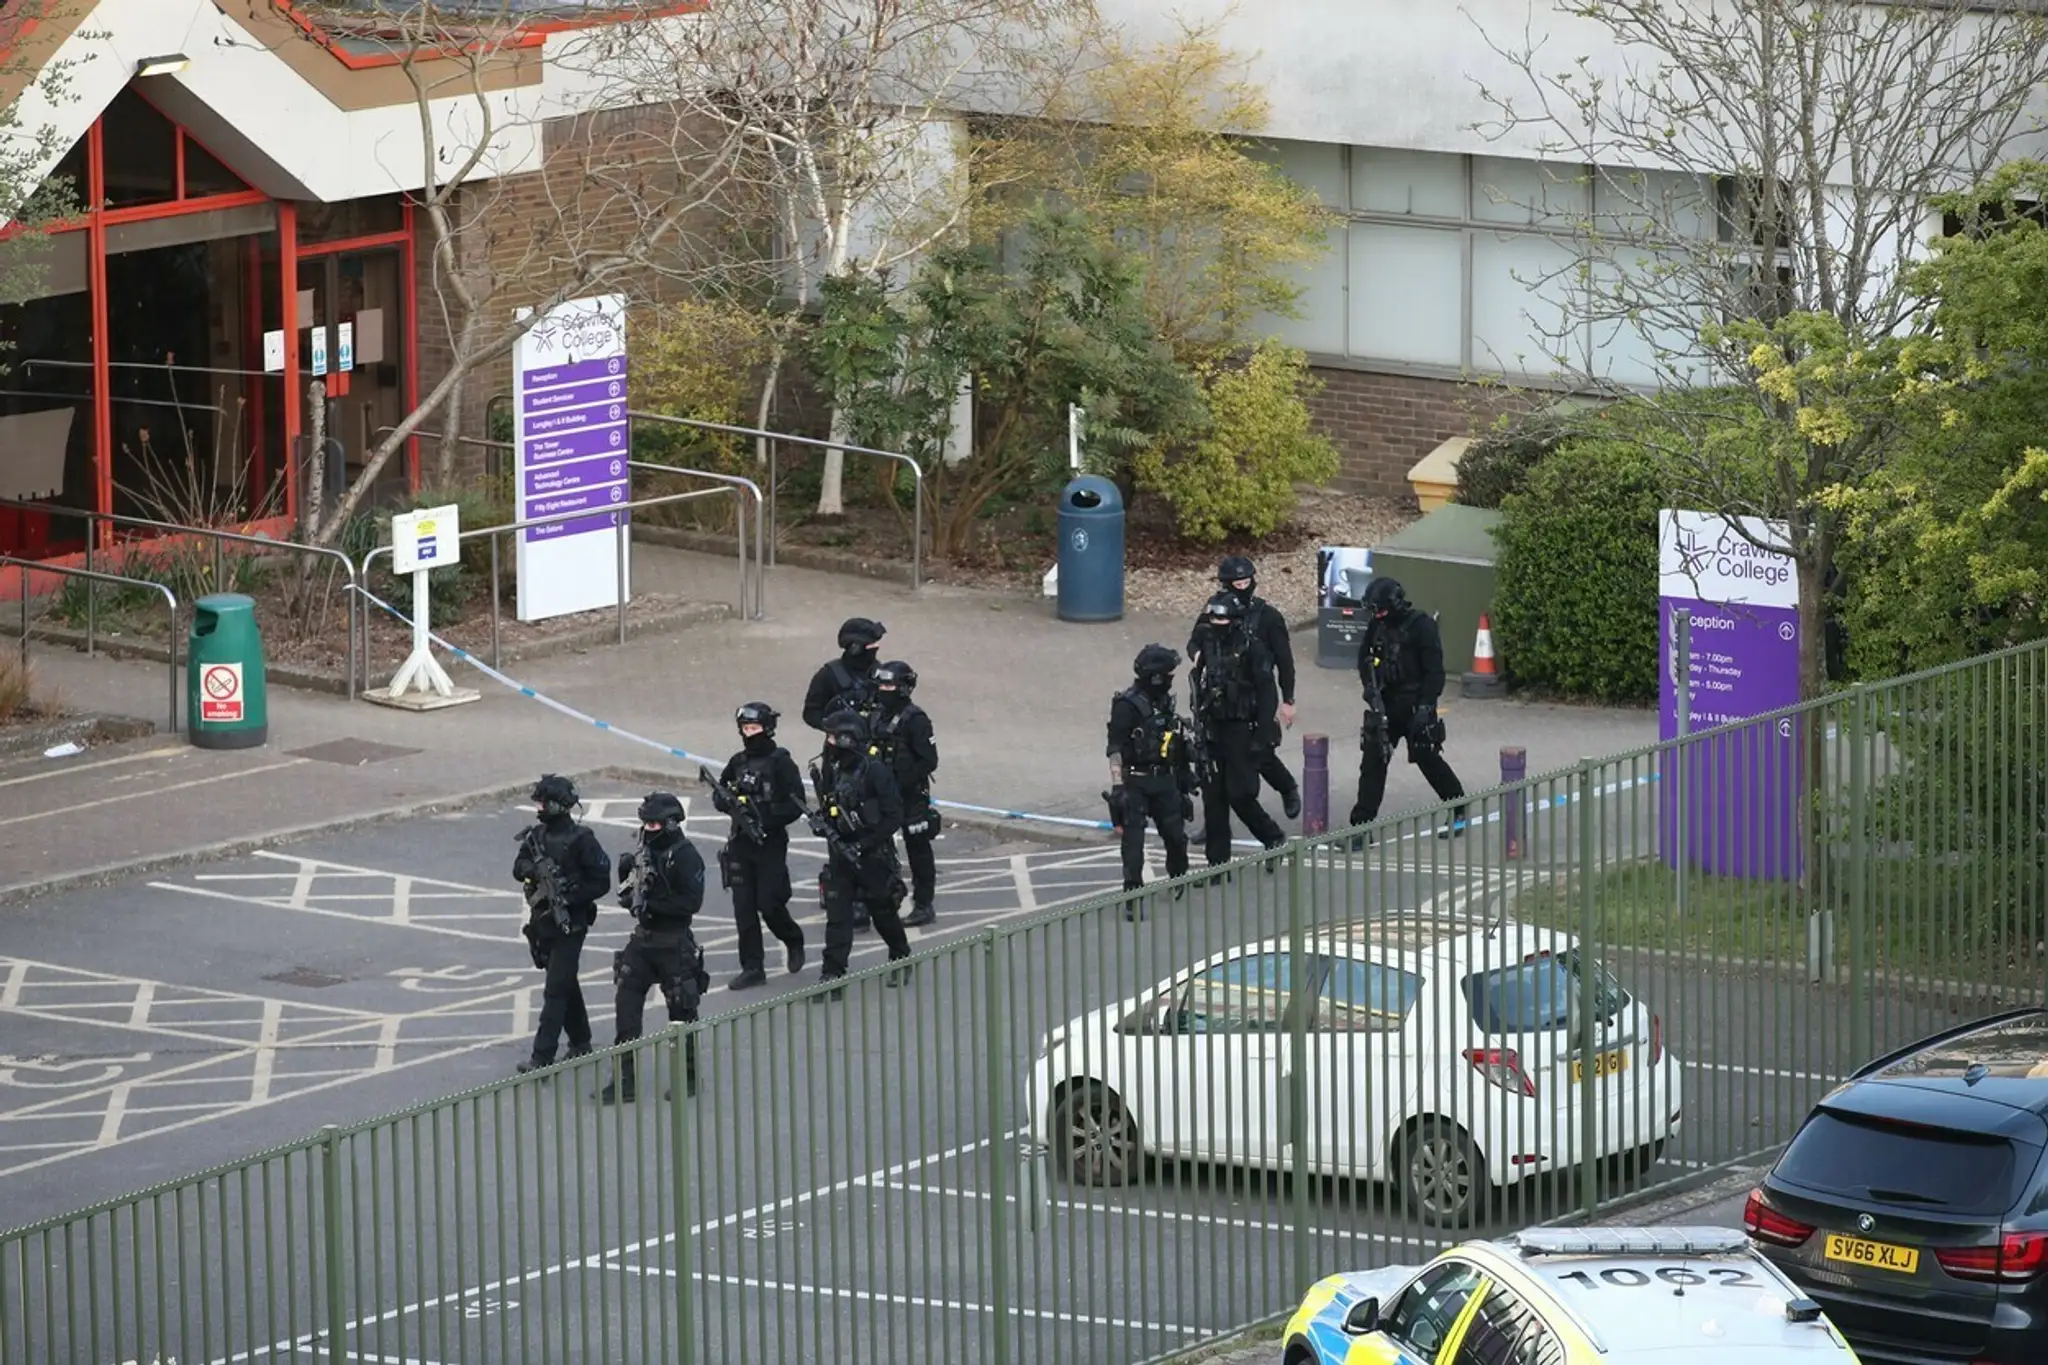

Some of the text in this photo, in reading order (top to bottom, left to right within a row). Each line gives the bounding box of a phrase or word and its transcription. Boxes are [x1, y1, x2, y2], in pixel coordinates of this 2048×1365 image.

[562, 330, 612, 350] College
[531, 373, 558, 383] Reception
[1717, 557, 1789, 586] College
[1689, 615, 1735, 631] ception
[1708, 664, 1743, 678] Thursday
[1833, 1238, 1912, 1268] SV66 XLJ
[1557, 1267, 1766, 1291] 1062
